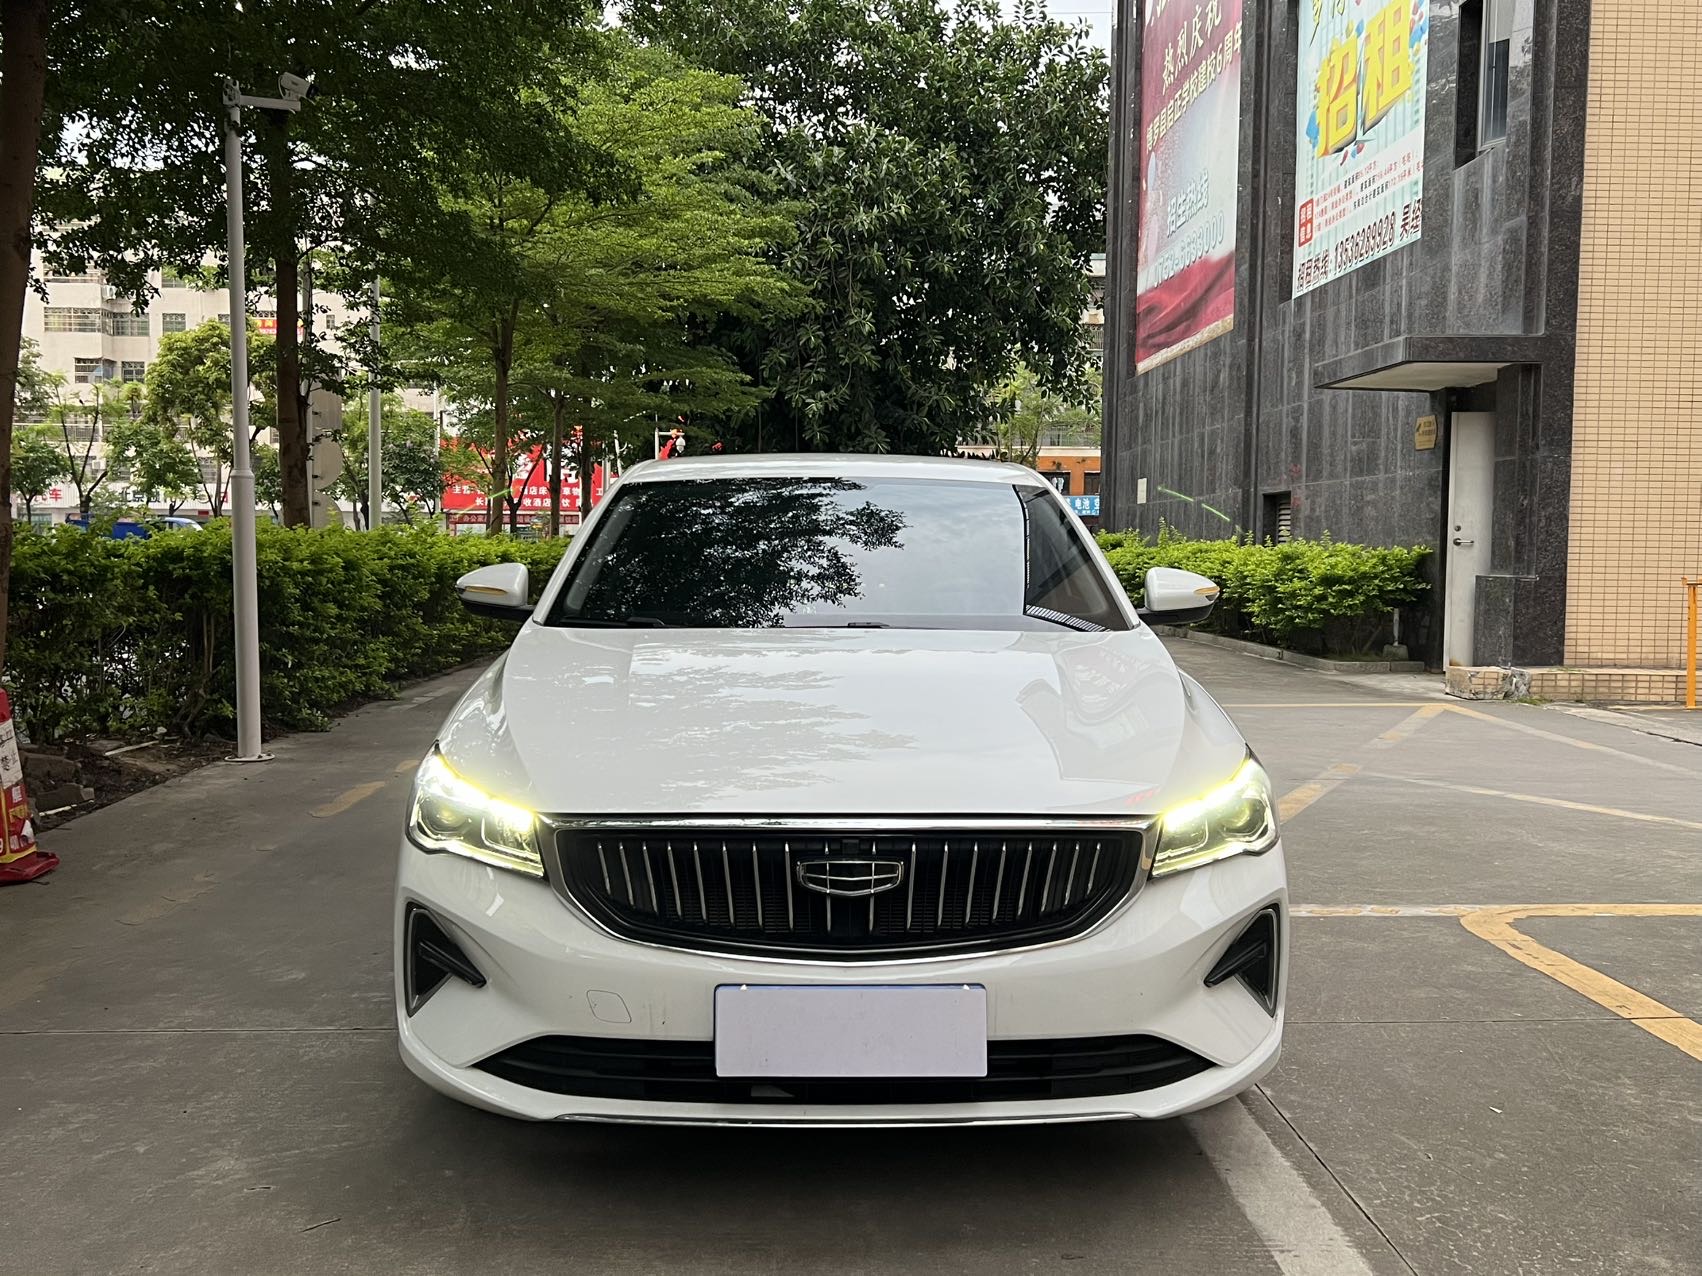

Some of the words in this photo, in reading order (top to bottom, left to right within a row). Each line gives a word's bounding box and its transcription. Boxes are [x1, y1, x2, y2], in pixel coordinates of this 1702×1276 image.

[1162, 0, 1222, 96] 热烈庆祝
[1316, 0, 1412, 159] 招租
